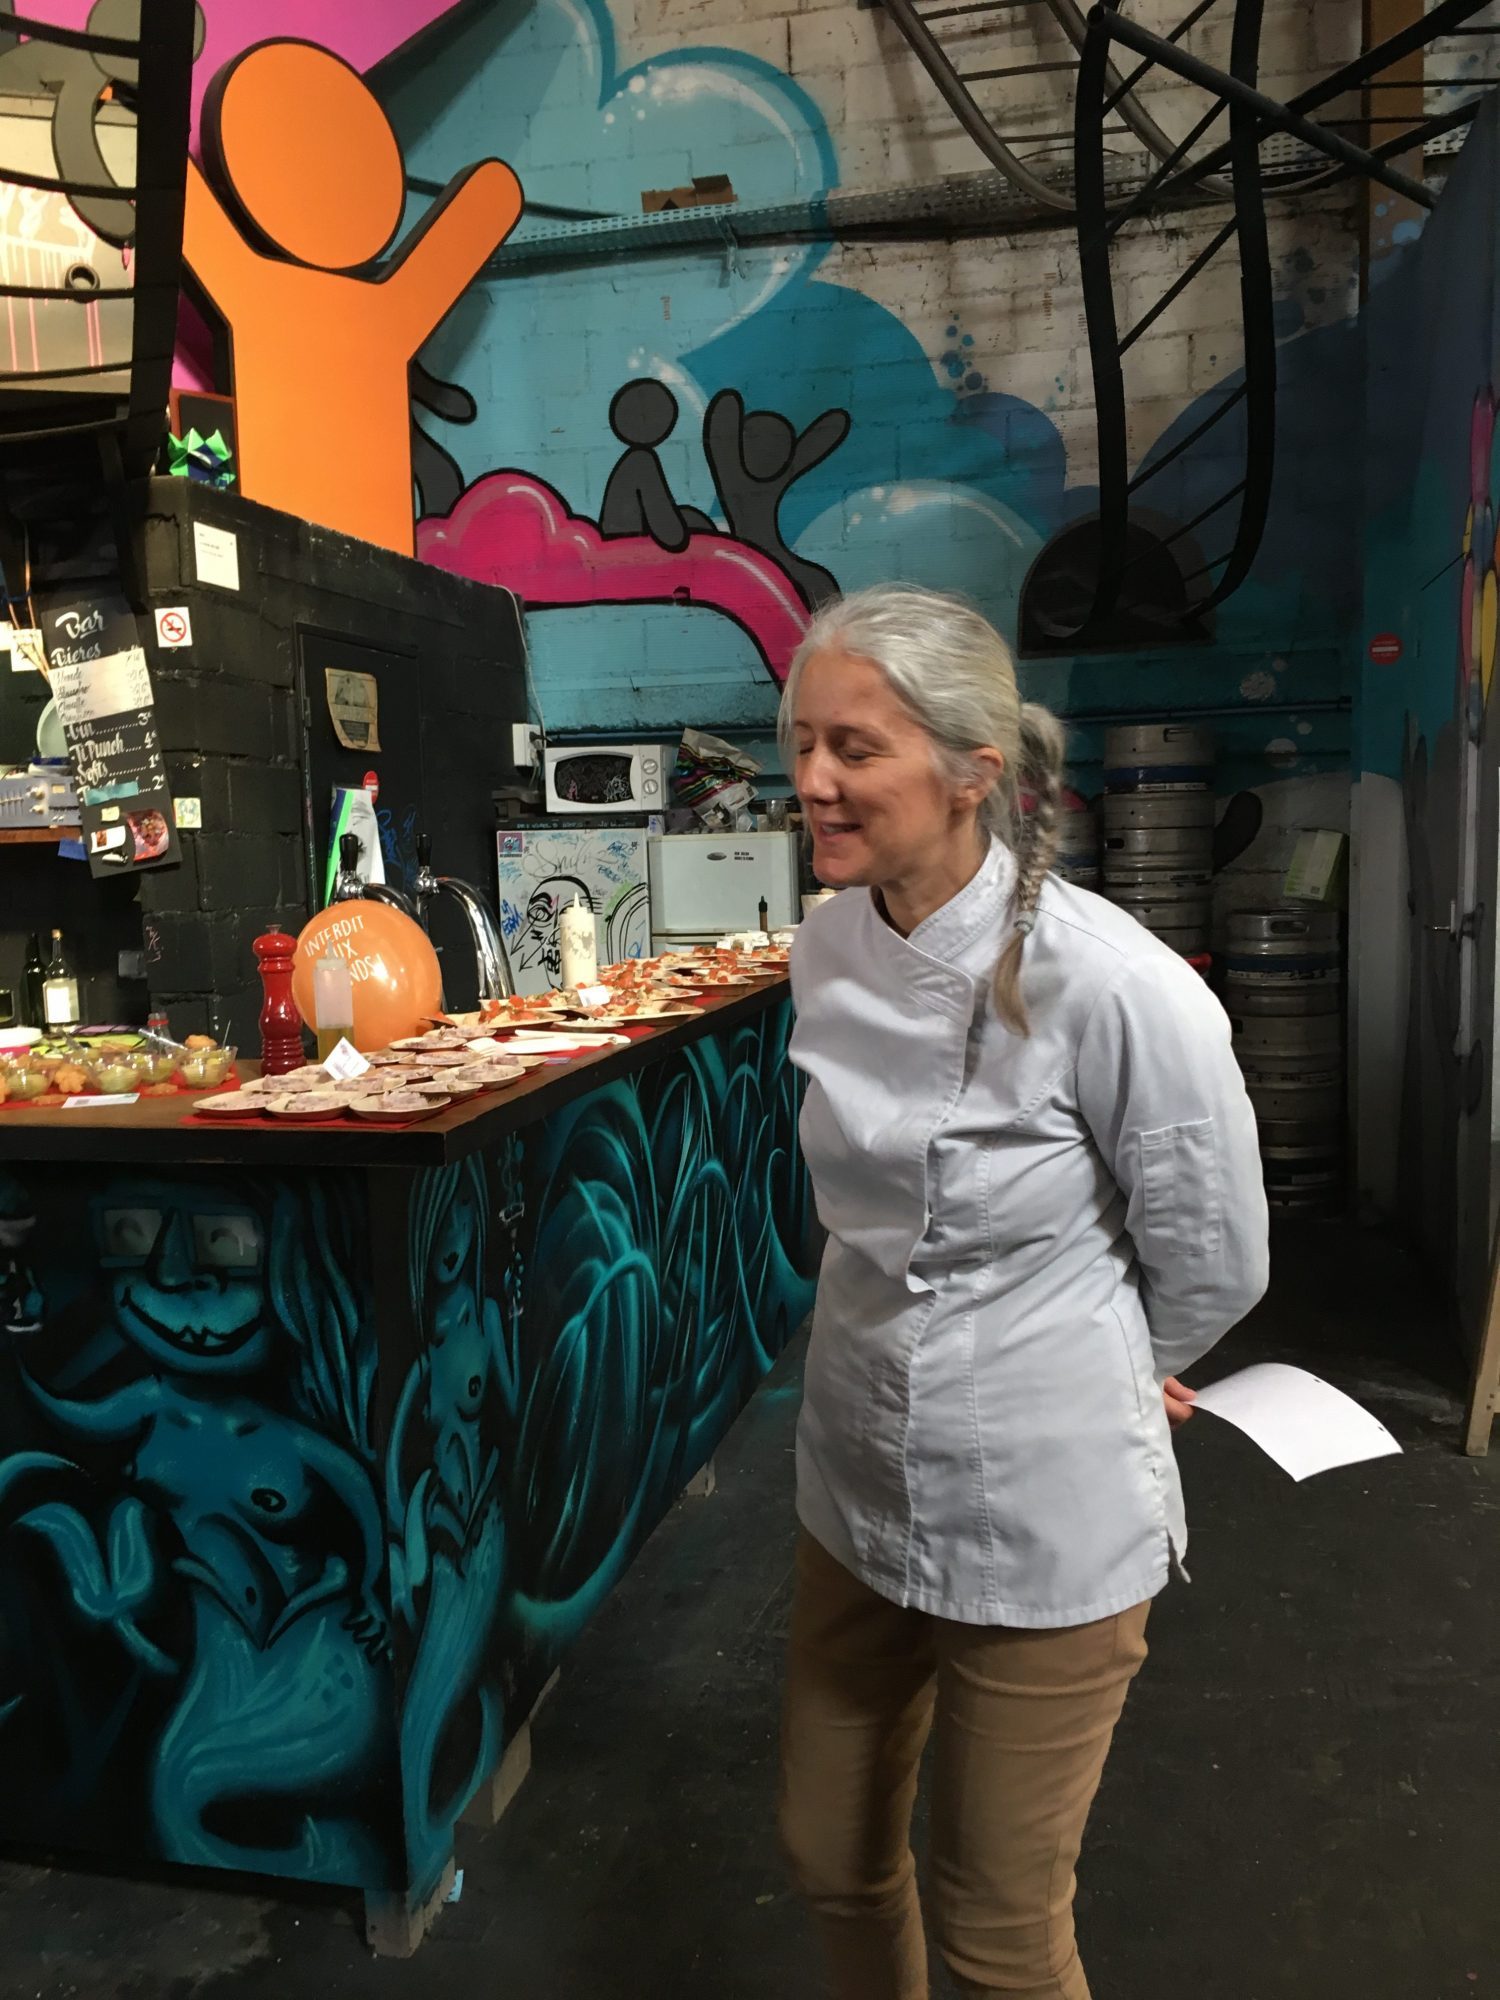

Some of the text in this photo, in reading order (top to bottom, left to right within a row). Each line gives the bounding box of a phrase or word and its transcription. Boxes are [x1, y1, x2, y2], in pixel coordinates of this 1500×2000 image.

[55, 609, 105, 639] Bar
[85, 732, 125, 760] Punch
[77, 760, 108, 786] Softs
[304, 915, 364, 957] INTERDIT
